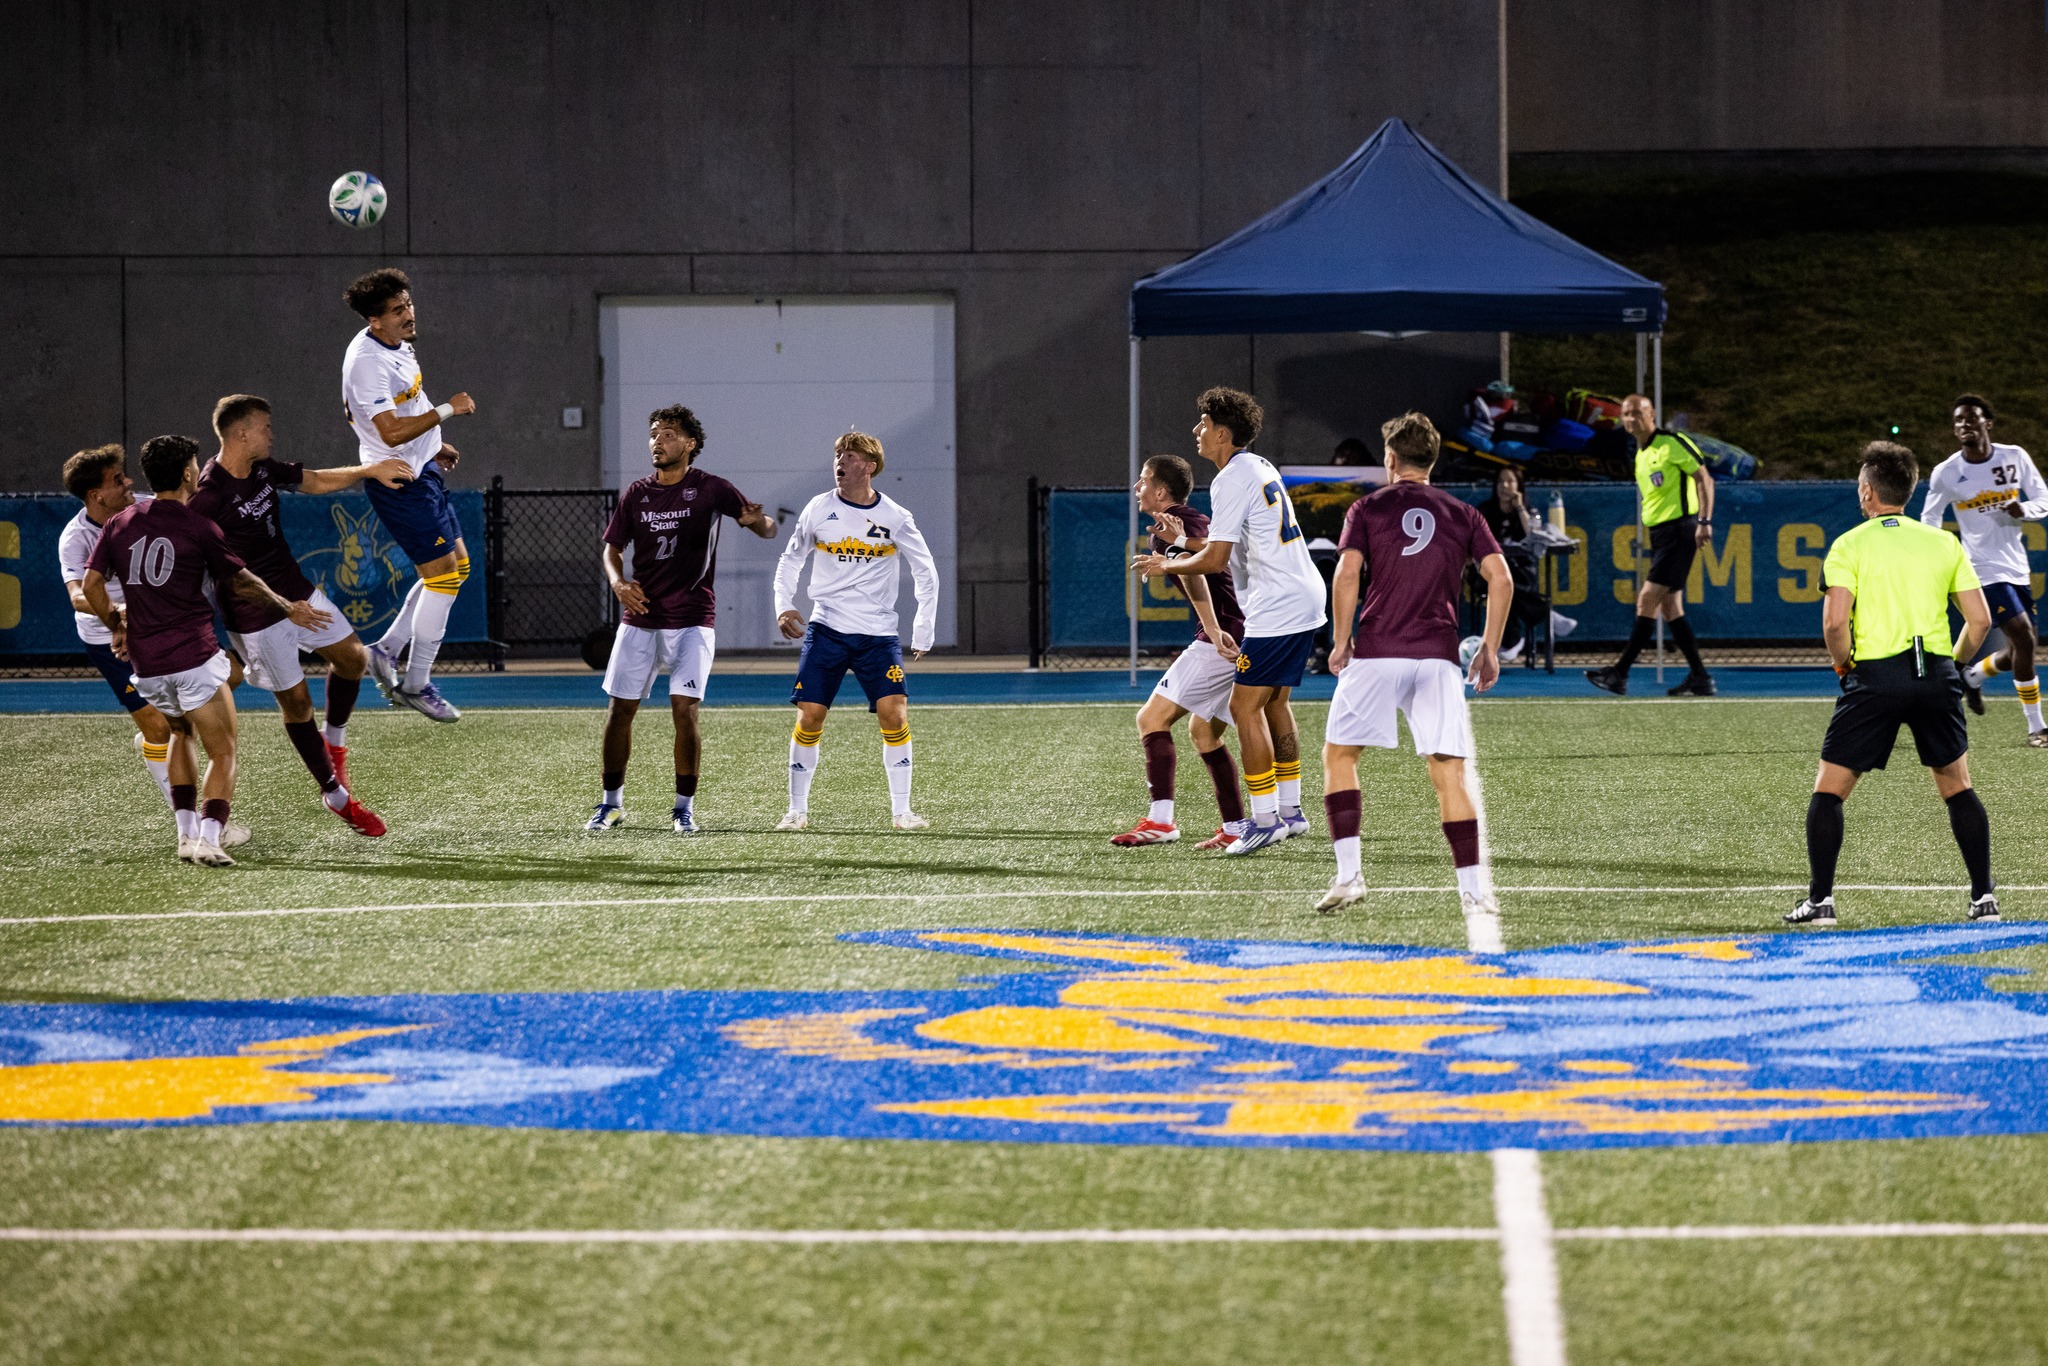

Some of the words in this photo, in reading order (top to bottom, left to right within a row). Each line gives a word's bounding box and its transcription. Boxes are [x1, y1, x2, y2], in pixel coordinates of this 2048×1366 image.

[1991, 464, 2018, 486] 32
[238, 483, 274, 518] Missouri
[252, 499, 273, 520] State
[1966, 493, 2013, 508] KANSAS
[1978, 502, 2006, 513] CITY
[640, 507, 691, 522] Missouri
[649, 520, 680, 533] State
[1401, 507, 1436, 556] 9
[655, 534, 678, 560] 21
[826, 546, 884, 557] KANSAS
[126, 535, 175, 587] 10
[838, 555, 872, 563] CITY
